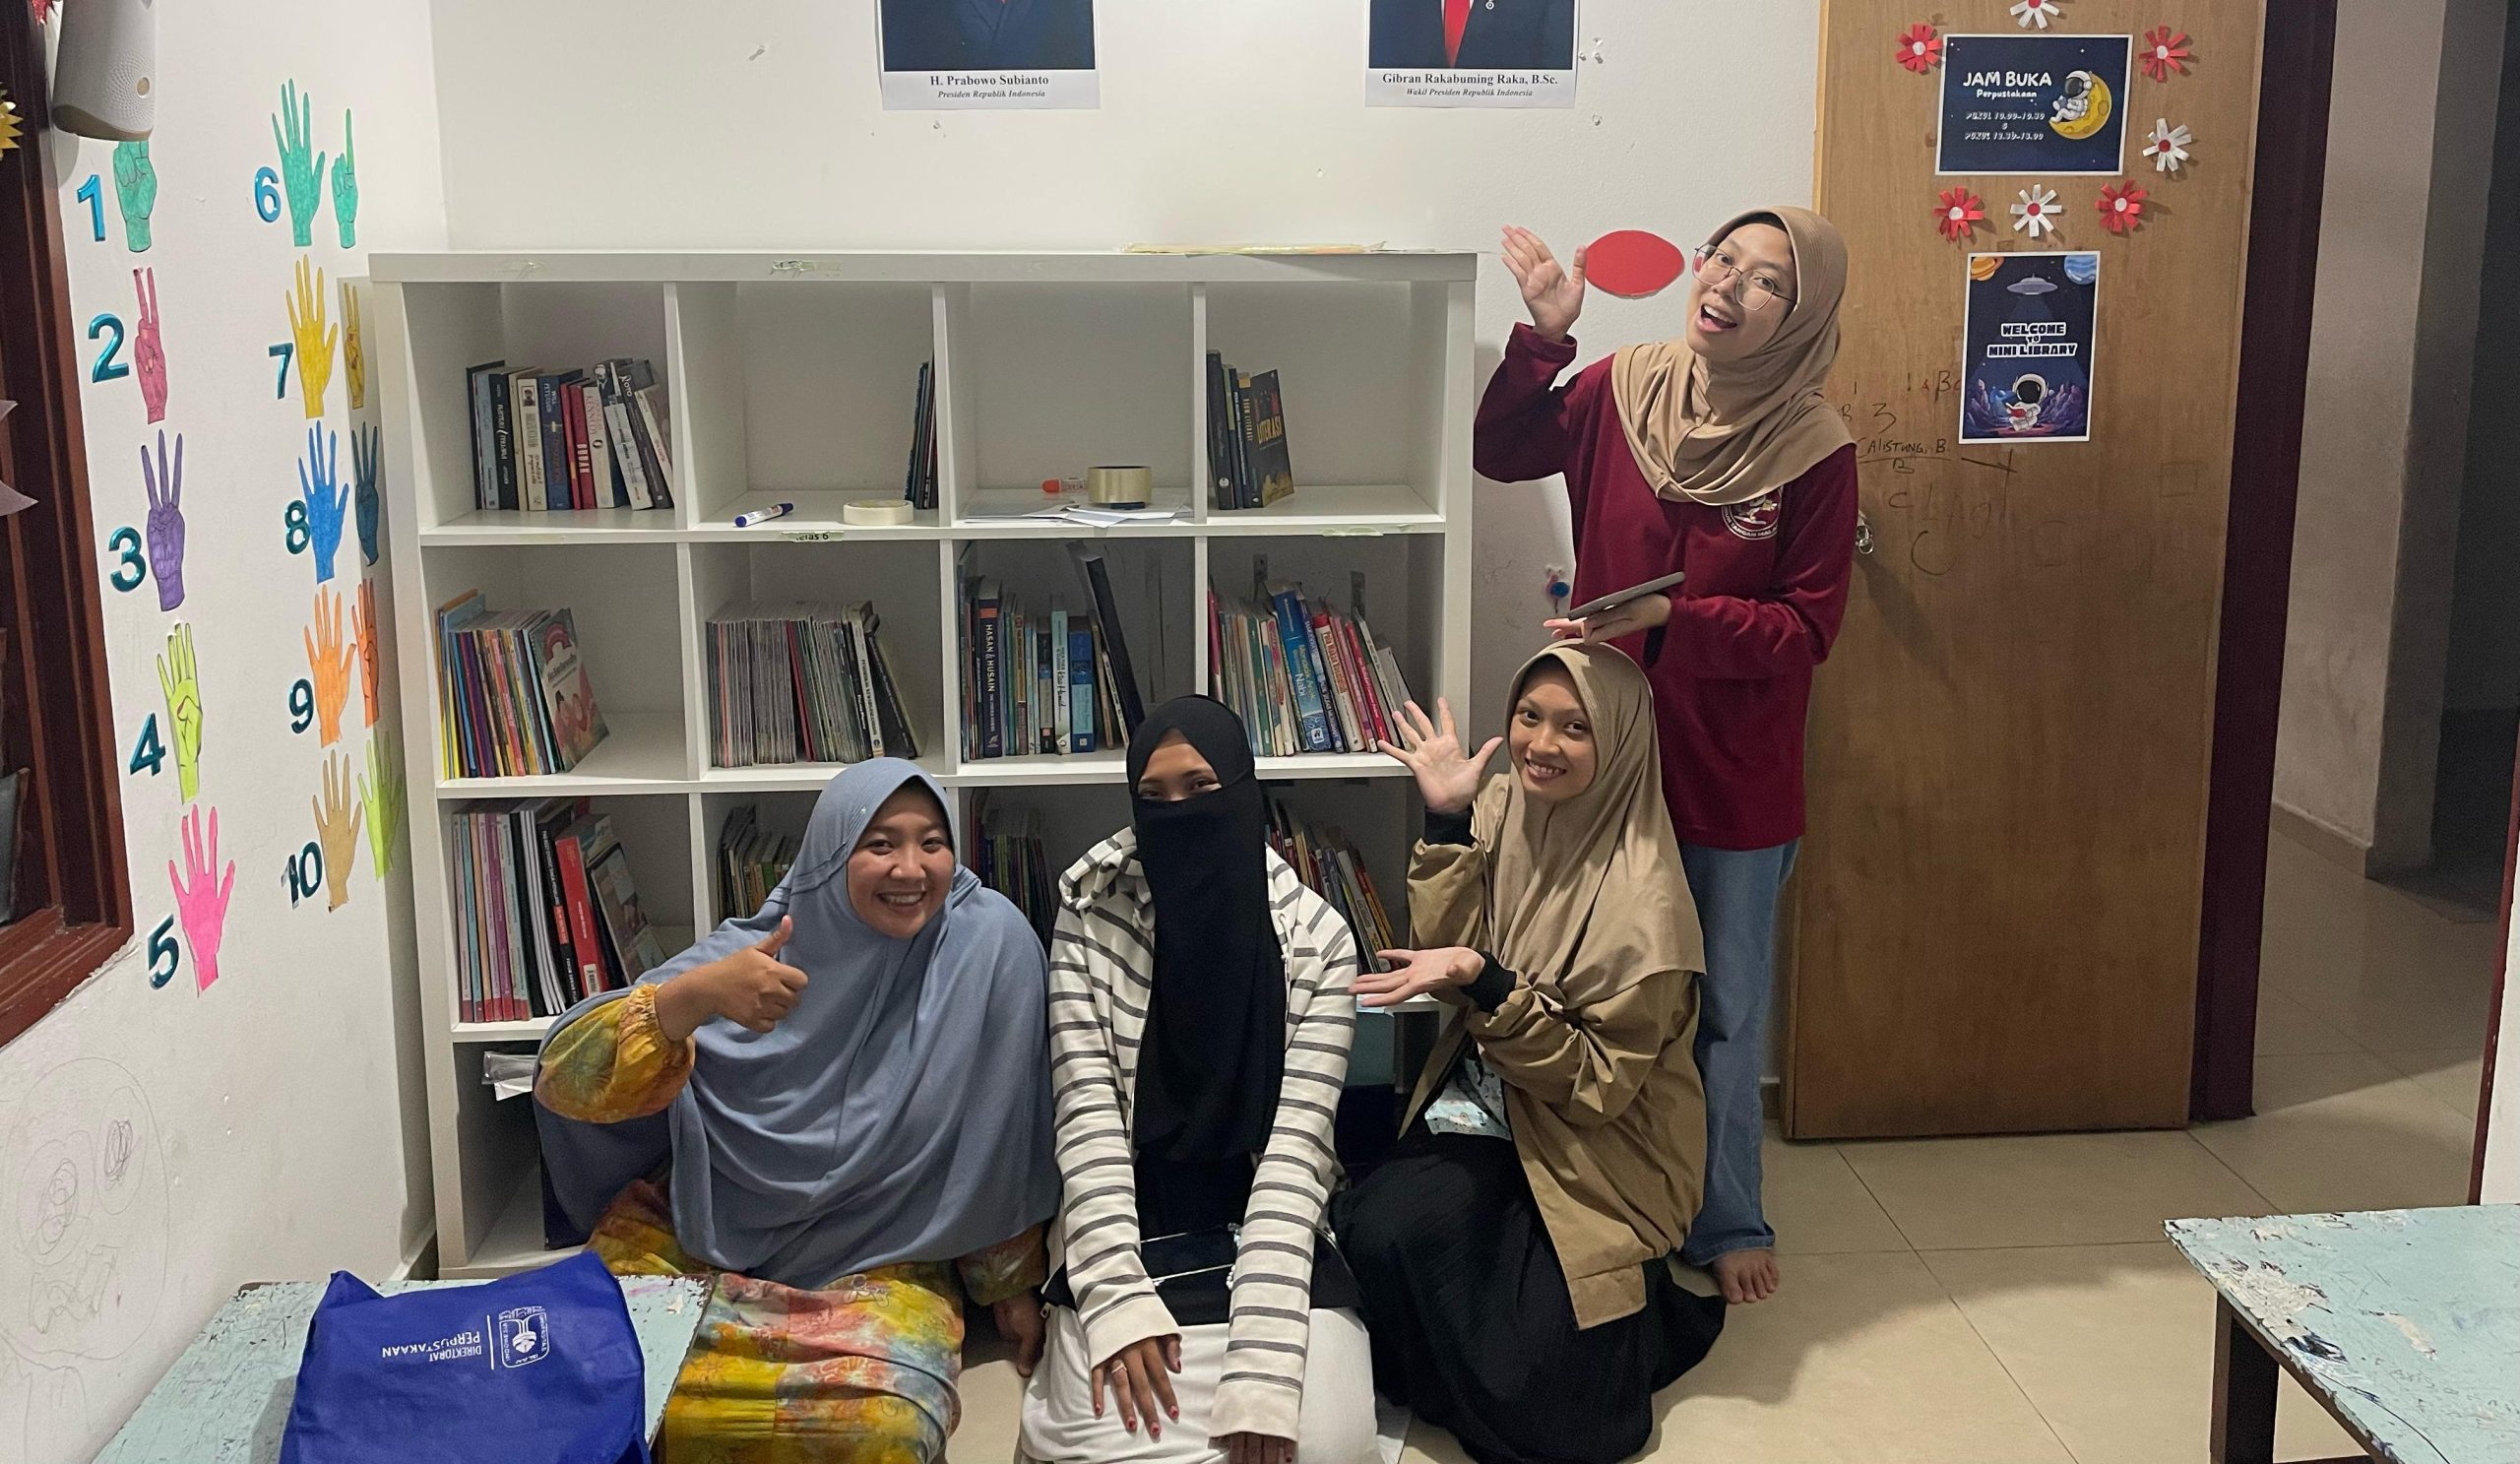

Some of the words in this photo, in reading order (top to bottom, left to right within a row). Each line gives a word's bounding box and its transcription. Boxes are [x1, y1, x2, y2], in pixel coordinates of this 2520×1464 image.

[930, 75, 943, 86] H.
[947, 75, 996, 86] Prabowo
[999, 75, 1049, 86] Subianto
[1382, 73, 1421, 85] Gibran
[1424, 73, 1494, 86] Rakabuming
[1496, 74, 1529, 86] Raka,
[1531, 74, 1558, 85] B.Sc.
[1406, 88, 1427, 96] Wakil
[1463, 89, 1494, 97] Republik
[1962, 71, 2000, 87] JAM
[2005, 71, 2052, 87] BUKA
[937, 90, 971, 98] Presiden
[973, 90, 1007, 99] Republik
[1009, 90, 1045, 98] Indonesia
[1976, 89, 2037, 99] Perpustakaan
[77, 174, 105, 242] 1
[254, 166, 282, 223] 6
[2001, 323, 2066, 336] WELCOME
[88, 313, 129, 383] 2
[1987, 345, 2016, 356] MINI
[2019, 344, 2077, 356] LIBRARY
[268, 343, 293, 400] 7
[284, 500, 310, 555] 8
[108, 527, 147, 592] 3
[984, 624, 995, 652] HASAN
[986, 660, 996, 692] HUSAIN
[1294, 672, 1307, 697] Nabi
[289, 678, 314, 734] 9
[130, 712, 166, 777] 4
[282, 841, 323, 910] 10
[148, 914, 180, 989] 5
[382, 1330, 481, 1359] PERPUSTAKAAN
[428, 1345, 482, 1363] DIREKTORAT
